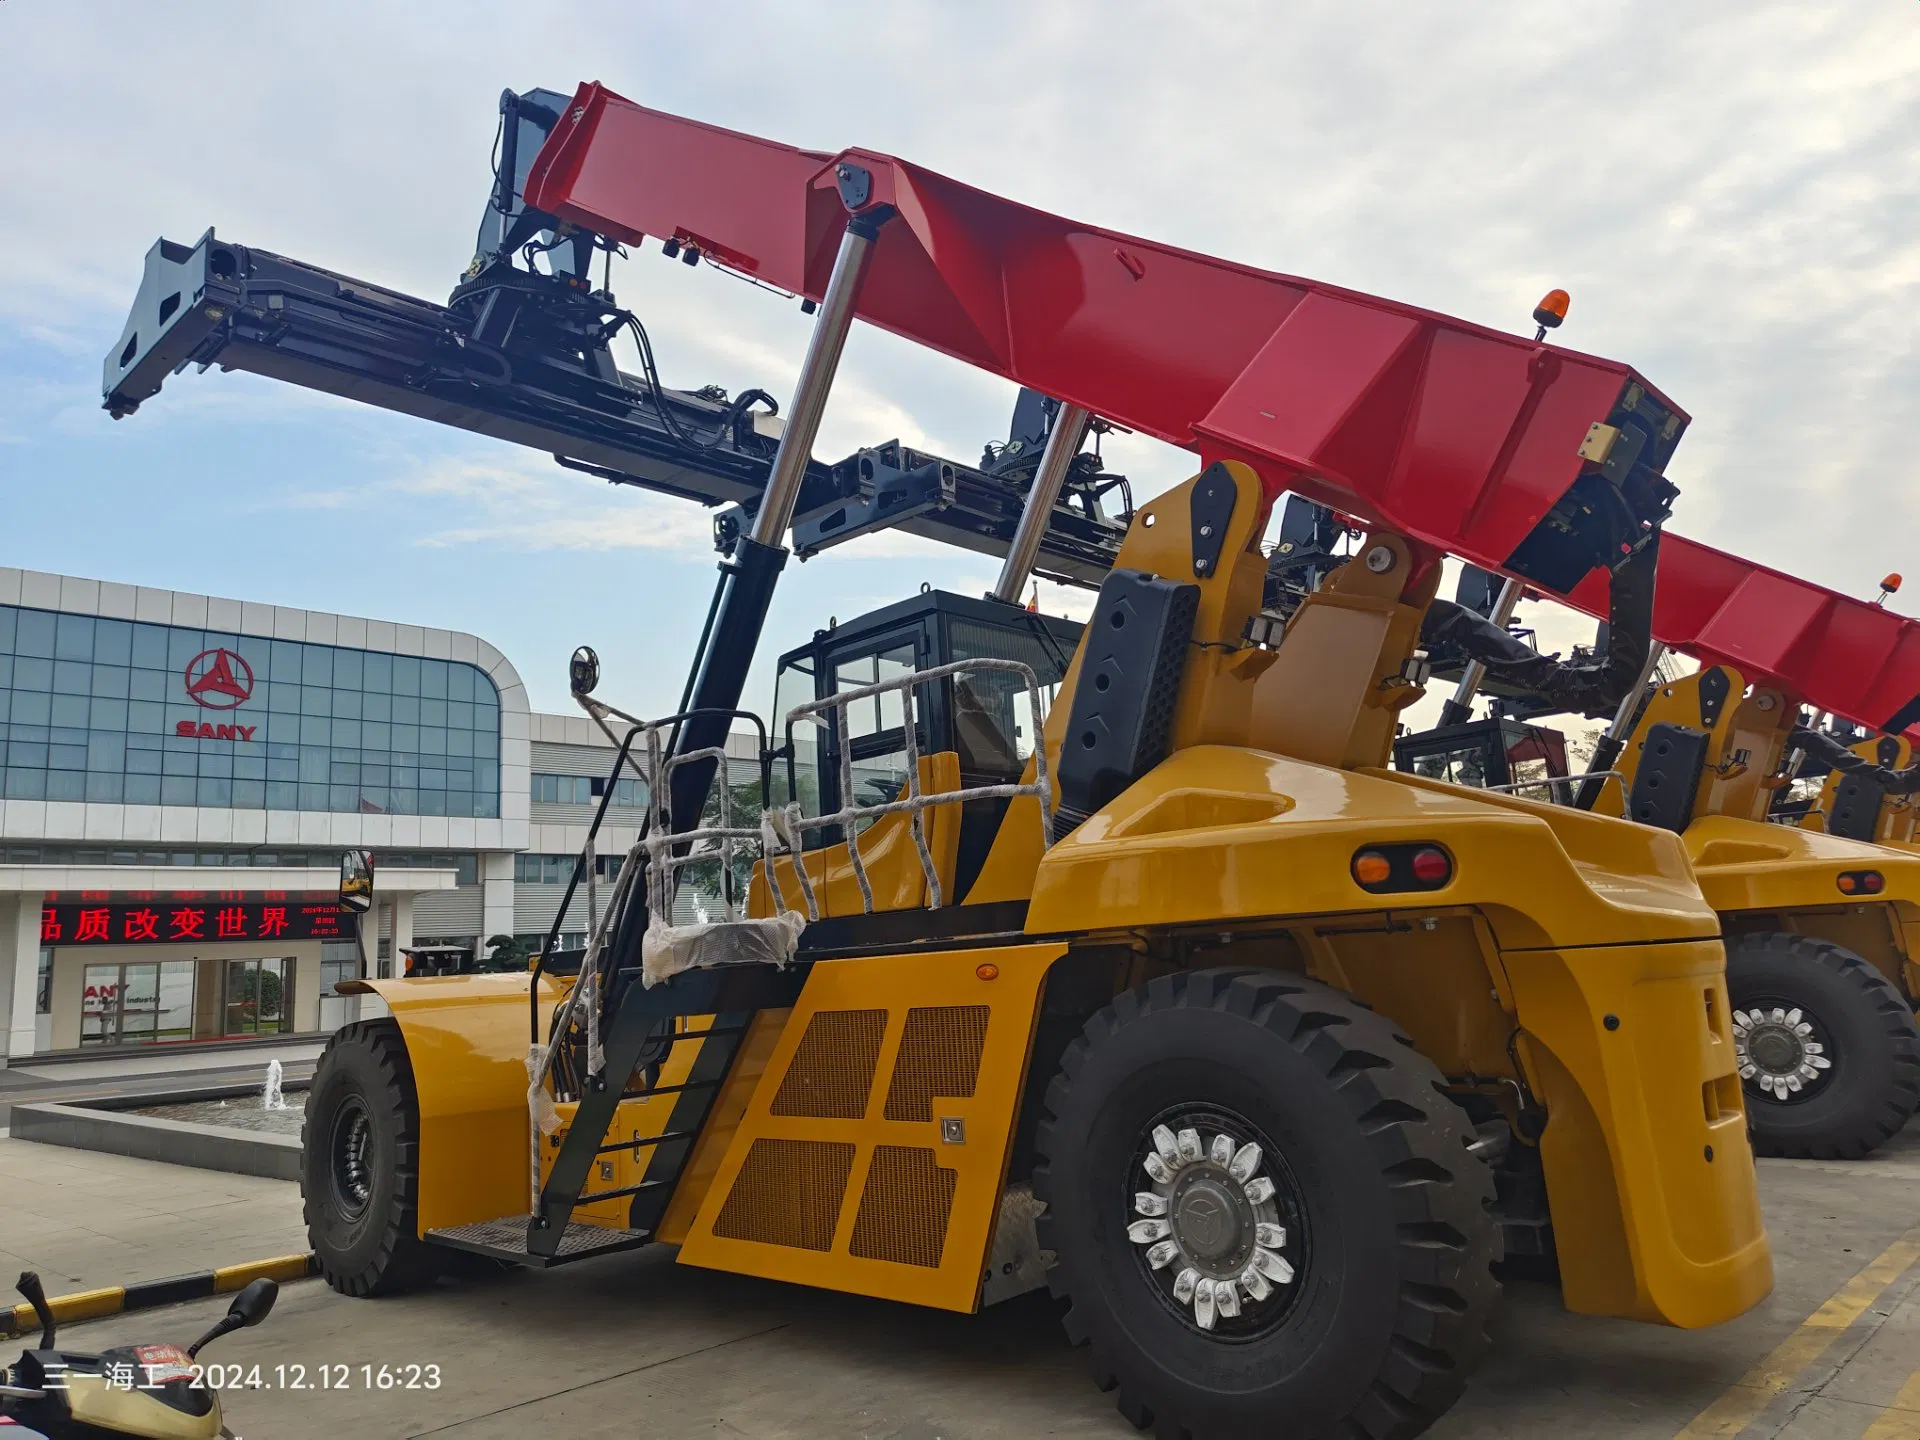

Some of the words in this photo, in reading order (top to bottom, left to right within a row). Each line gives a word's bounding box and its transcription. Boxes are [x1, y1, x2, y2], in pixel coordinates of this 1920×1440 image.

[176, 720, 257, 742] SANY
[41, 907, 289, 941] 品质改变世界
